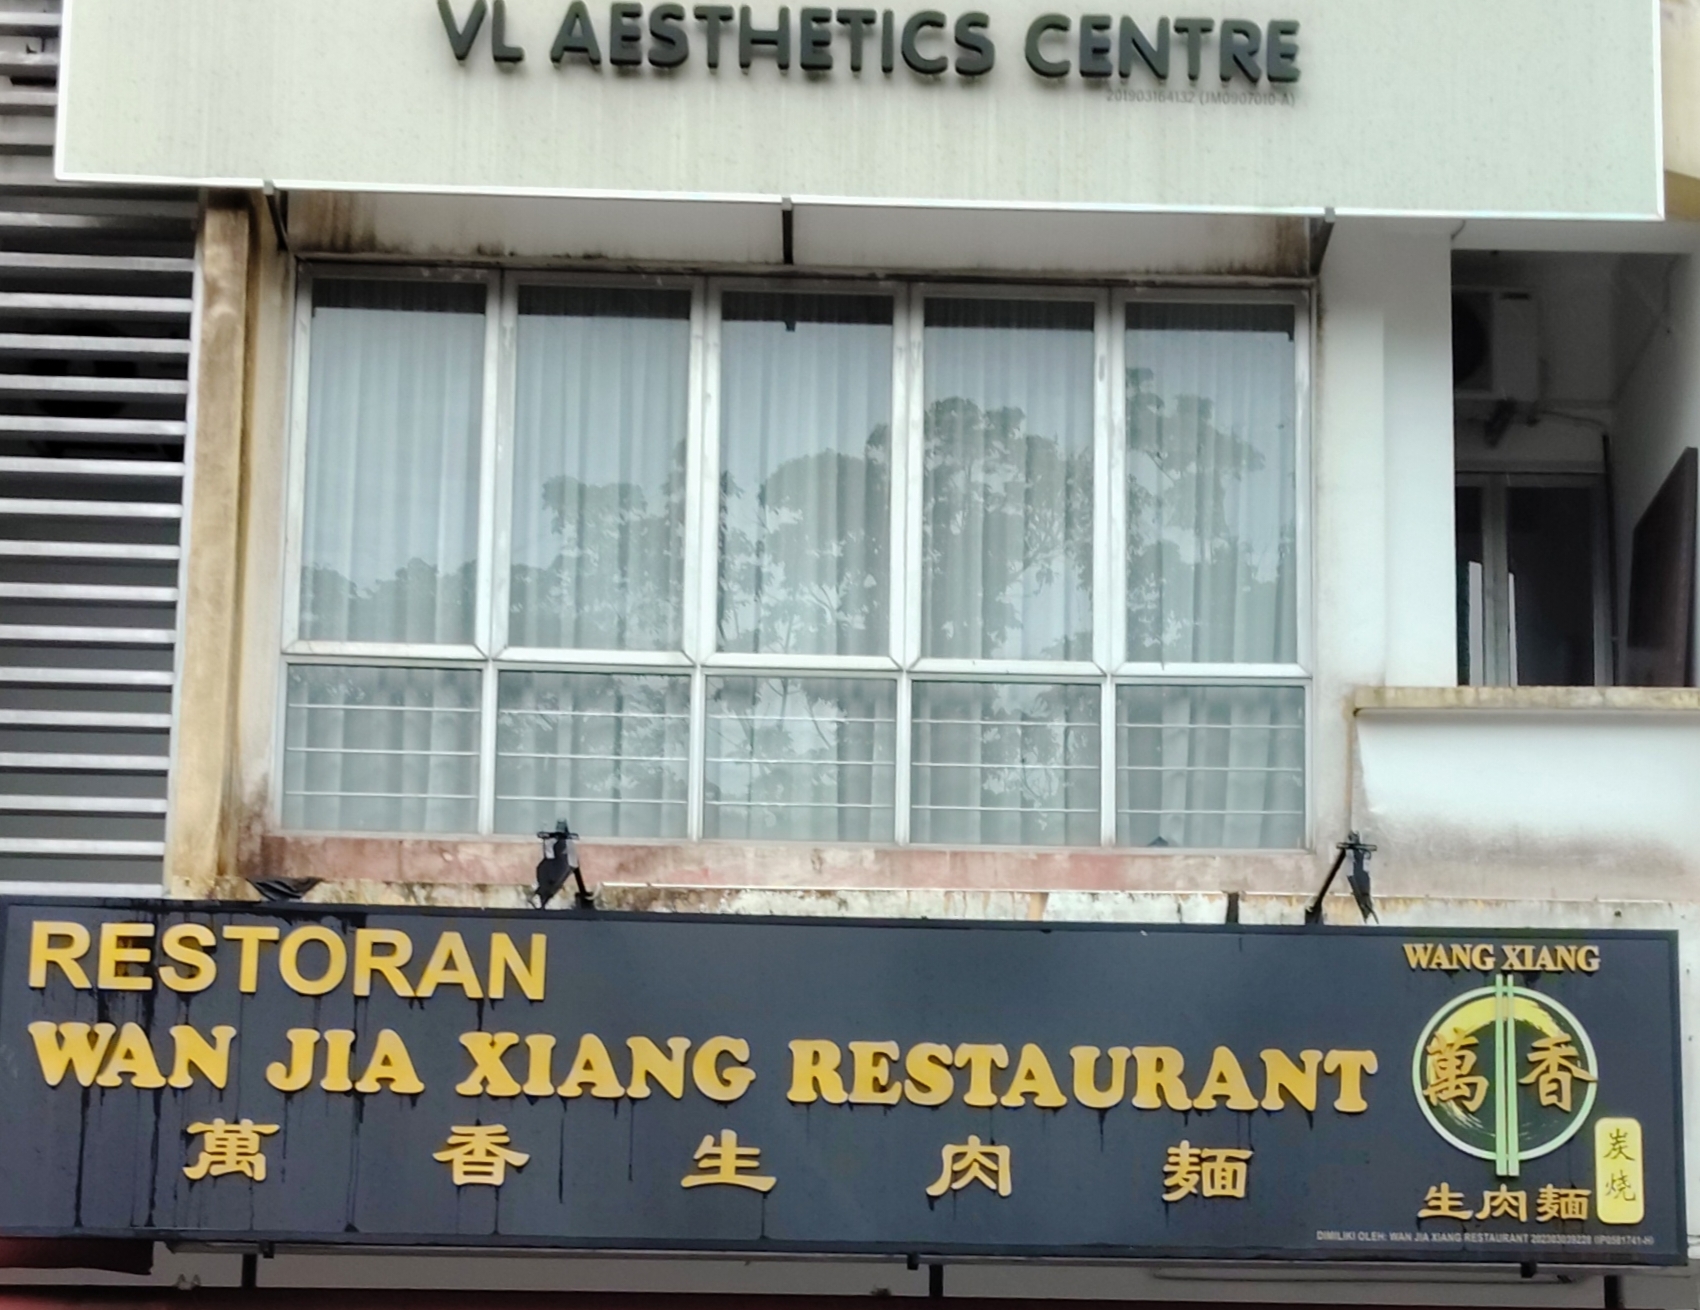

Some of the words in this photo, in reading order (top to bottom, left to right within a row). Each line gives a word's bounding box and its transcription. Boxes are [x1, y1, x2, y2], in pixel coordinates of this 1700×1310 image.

[437, 0, 525, 62] VL
[550, 0, 995, 76] AESTHETICS
[1025, 13, 1301, 83] CENTRE
[28, 920, 548, 1001] RESTORAN
[1402, 943, 1496, 971] WANG
[1501, 944, 1601, 972] XIANG
[28, 1021, 234, 1090] WAN
[265, 1027, 425, 1095] JIA
[455, 1031, 756, 1102] XIANG
[786, 1038, 1379, 1114] RESTAURANT
[1316, 1229, 1356, 1241] DIMILIKI
[1389, 1231, 1412, 1242] WAN
[1414, 1231, 1430, 1242] JIA
[1431, 1231, 1463, 1243] XIANG
[1464, 1232, 1529, 1244] RESTAURANT
